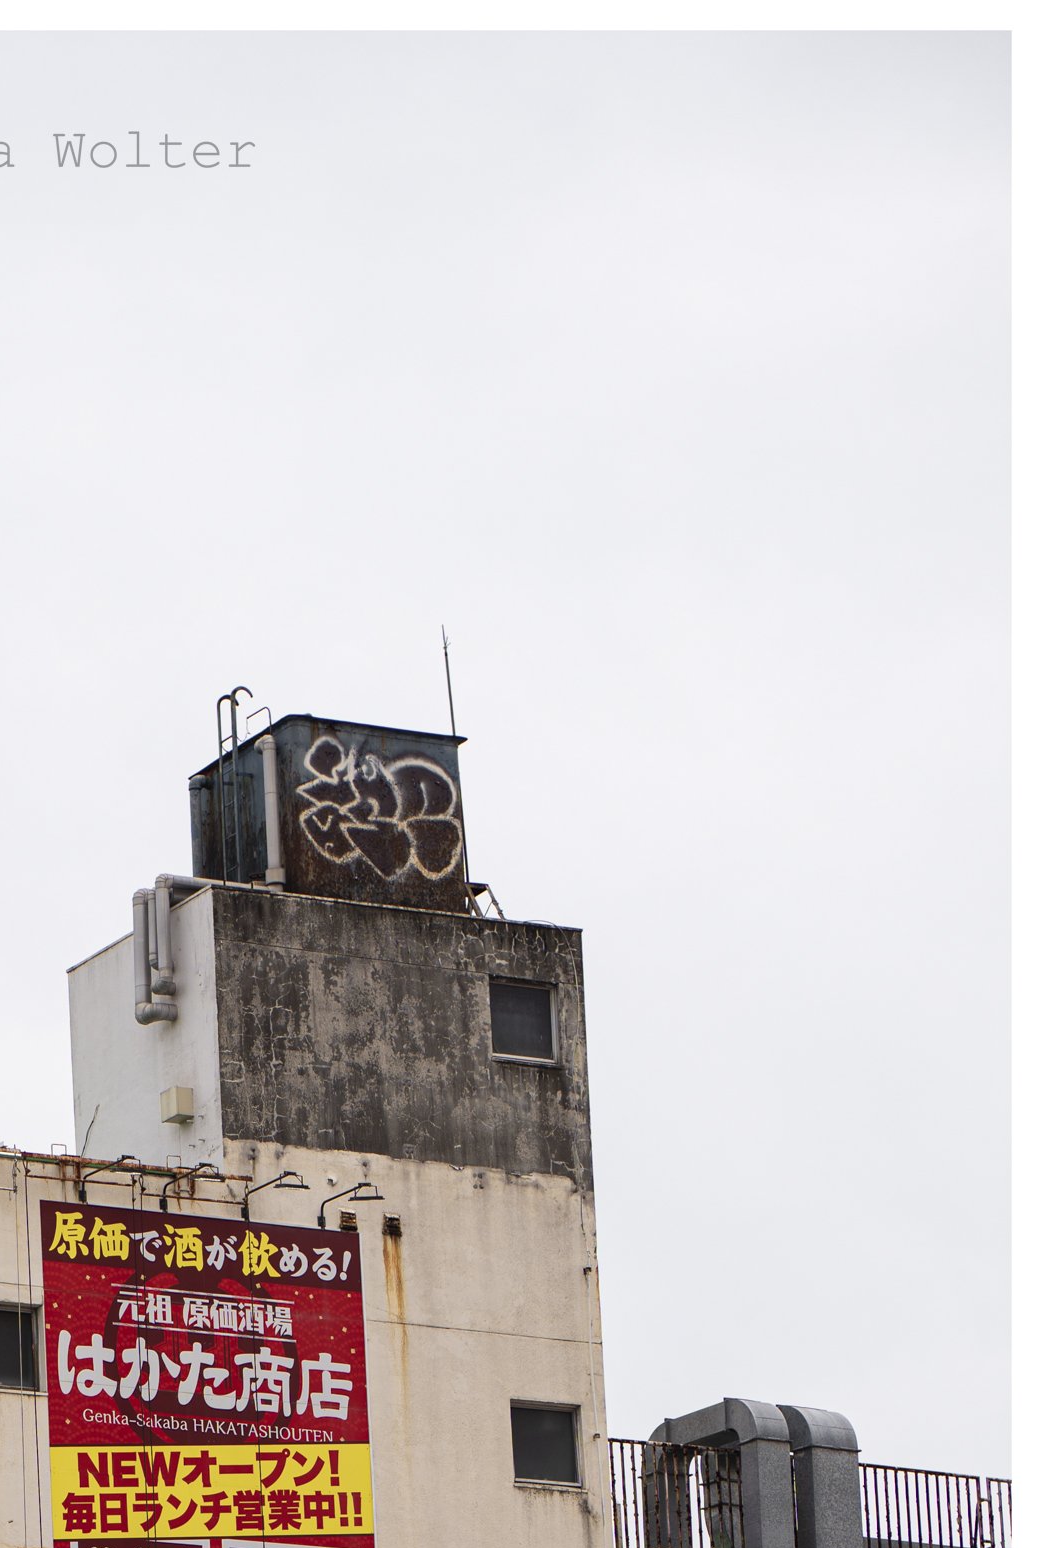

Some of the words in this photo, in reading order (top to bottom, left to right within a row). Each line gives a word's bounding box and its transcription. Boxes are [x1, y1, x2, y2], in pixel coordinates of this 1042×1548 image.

[118, 1291, 174, 1325] 元祖
[183, 1297, 294, 1337] 原価酒場
[57, 1329, 354, 1421] はかた商店
[82, 1408, 189, 1432] Genka-Sakaba
[192, 1418, 334, 1443] HAKATASHOUTEN
